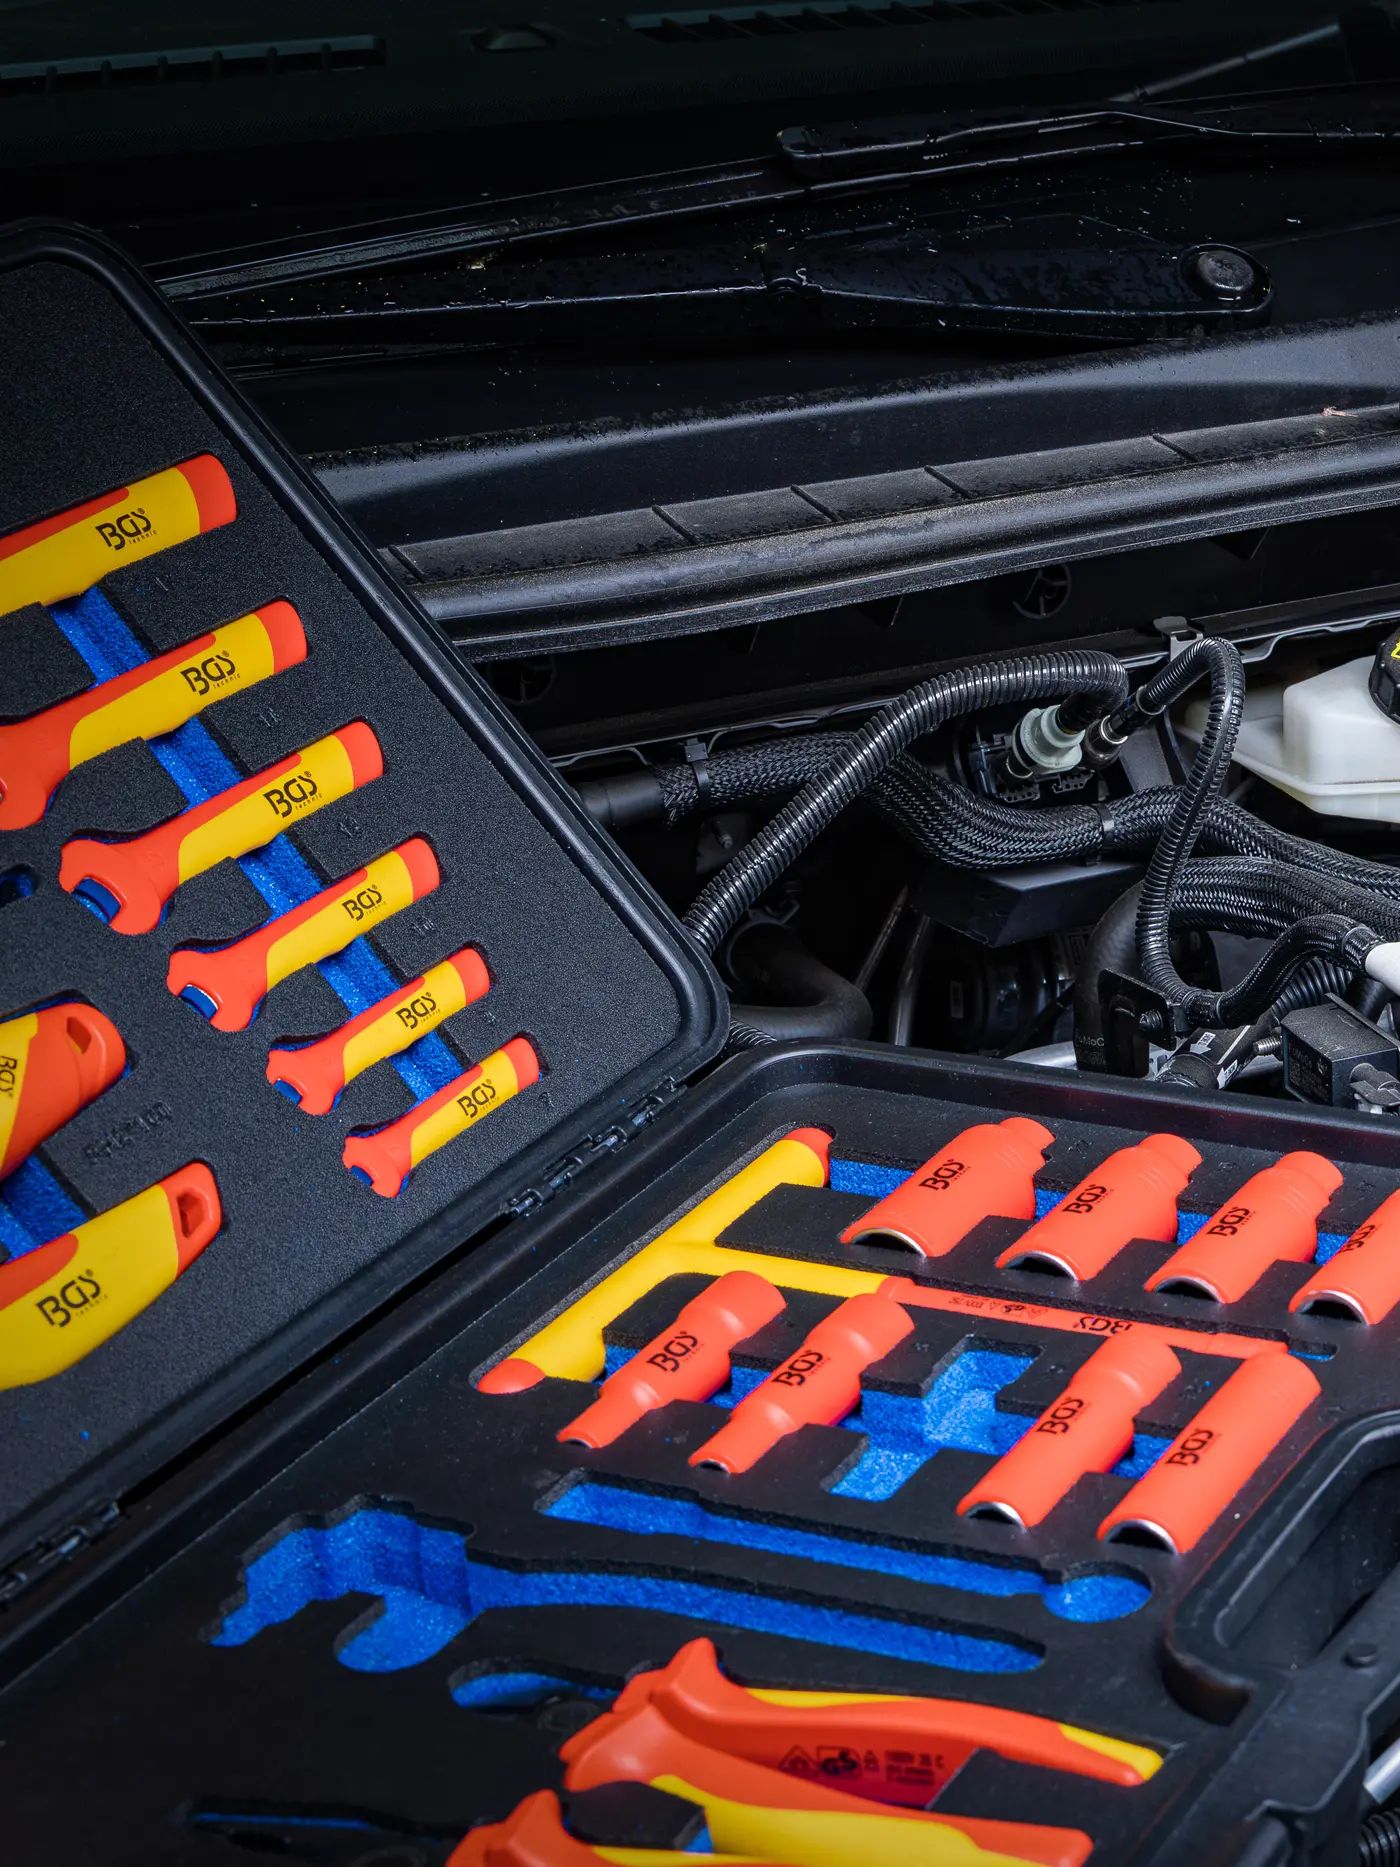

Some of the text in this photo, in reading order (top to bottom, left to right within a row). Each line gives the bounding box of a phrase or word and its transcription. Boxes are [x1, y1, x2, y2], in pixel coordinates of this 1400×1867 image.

[95, 510, 152, 551] BGS
[180, 654, 236, 695] BGS
[262, 775, 318, 818] BGS
[342, 887, 382, 921] BGS
[395, 995, 437, 1030] BGS
[456, 1082, 496, 1119] BGS
[919, 1161, 965, 1190] BGS
[1062, 1184, 1107, 1214] BGS
[1206, 1207, 1250, 1237] BGS
[36, 1275, 101, 1328] BGS
[646, 1332, 698, 1372] BGS
[772, 1351, 824, 1386] BGS
[1037, 1398, 1084, 1435] BGS
[1165, 1429, 1214, 1467] BGS
